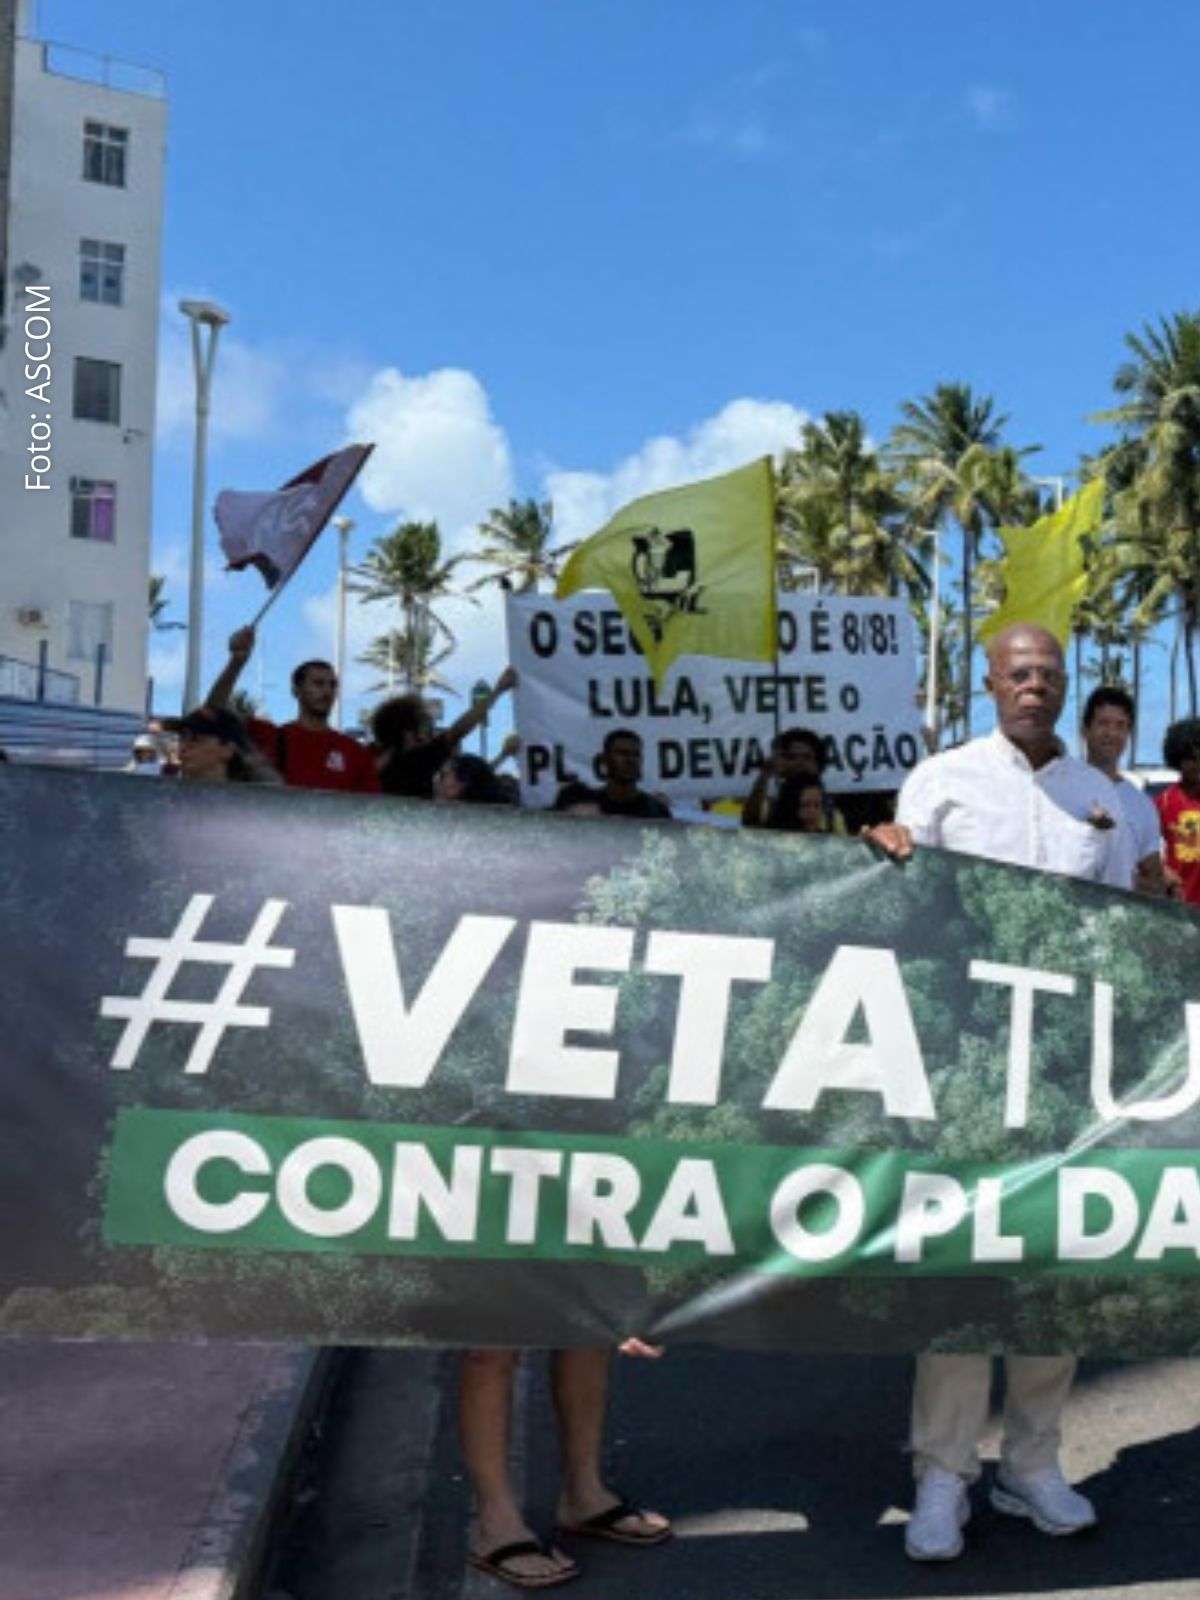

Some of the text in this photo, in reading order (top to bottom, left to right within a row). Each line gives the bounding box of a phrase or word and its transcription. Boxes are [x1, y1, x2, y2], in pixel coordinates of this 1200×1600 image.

[529, 610, 558, 658] O
[810, 600, 831, 654] É
[842, 610, 899, 656] 8/8!
[587, 675, 714, 725] LULA,
[722, 674, 829, 714] VETE
[526, 742, 579, 786] PL
[657, 724, 918, 783] DEVAAÇÃO
[162, 1128, 736, 1256] CONTRA
[768, 1162, 866, 1263] O
[892, 1171, 1025, 1264] PL
